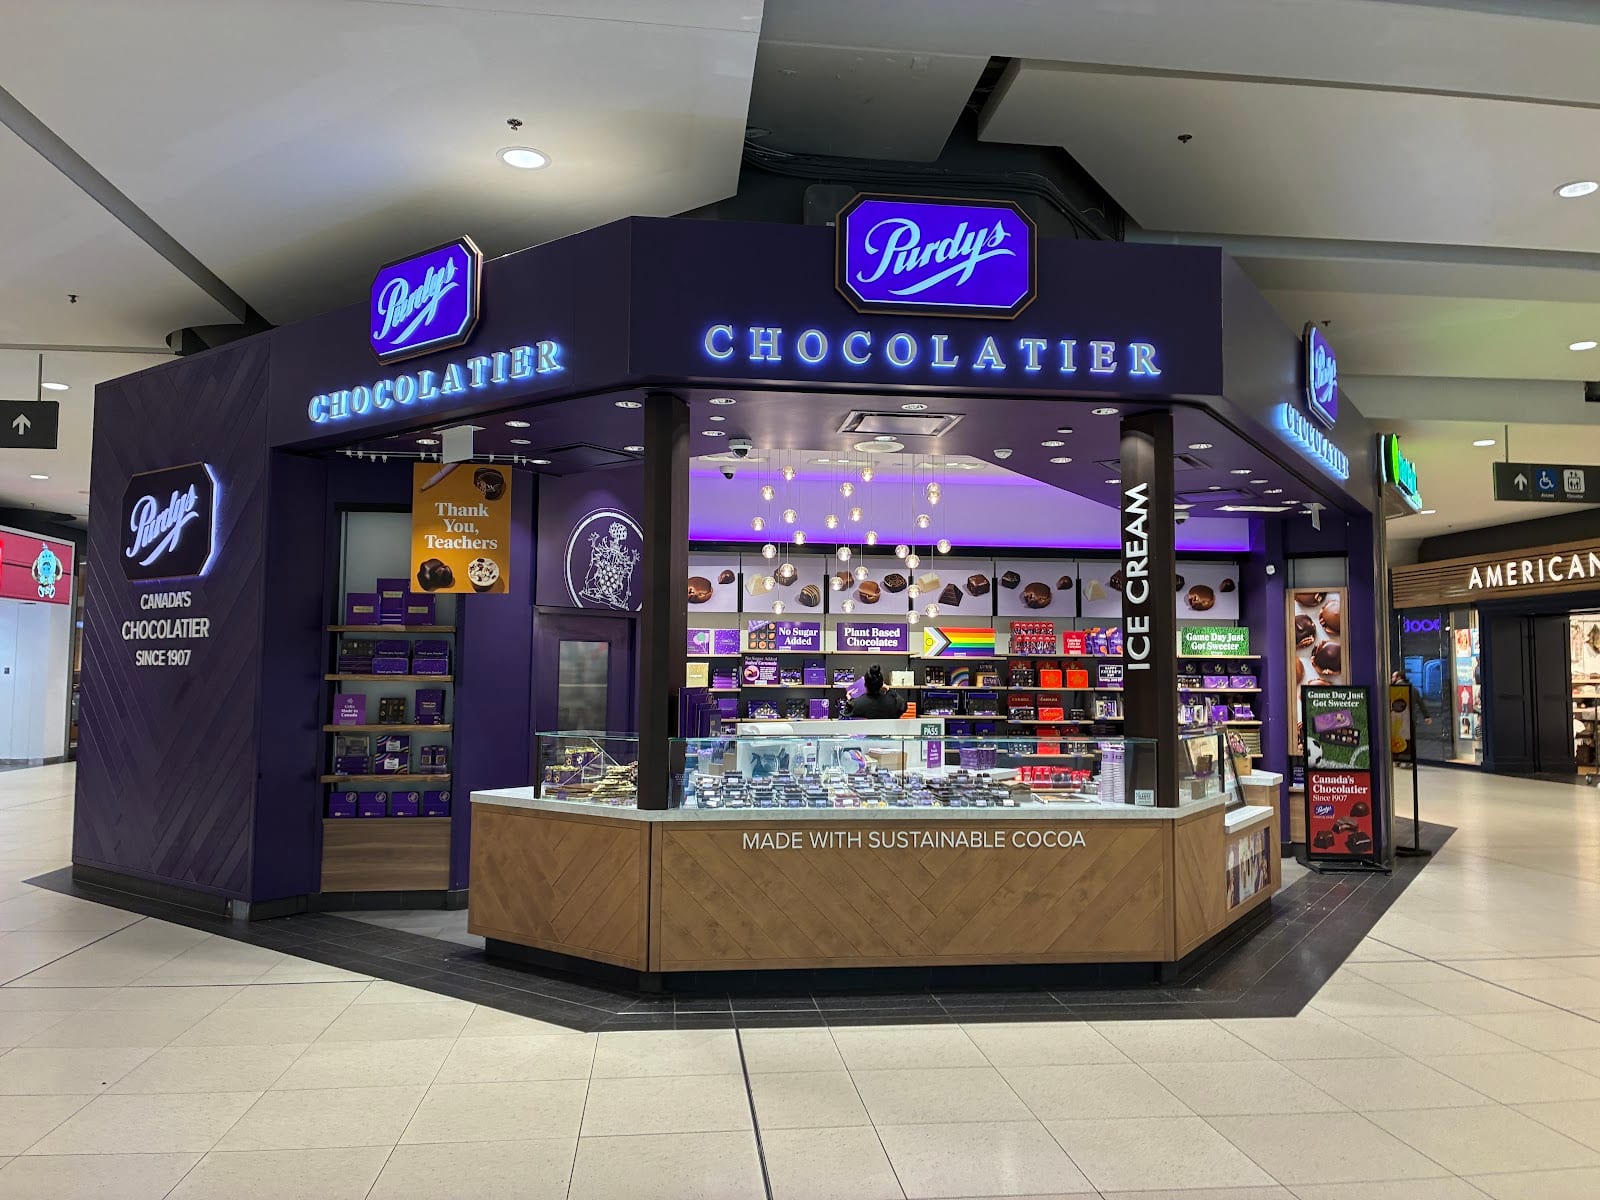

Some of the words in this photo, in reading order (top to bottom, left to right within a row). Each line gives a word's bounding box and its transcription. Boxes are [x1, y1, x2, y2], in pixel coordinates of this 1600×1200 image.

[856, 217, 1016, 296] Purdys
[373, 257, 460, 344] Purdys
[704, 324, 1162, 376] CHOCOLATIER
[308, 340, 562, 423] CHOCOLATIER
[435, 502, 489, 517] Thank
[126, 483, 199, 566] Purdys
[443, 518, 479, 535] You,
[424, 535, 498, 550] Teachers
[1124, 482, 1150, 604] CREAM
[1468, 551, 1600, 590] AMERICAN
[140, 591, 192, 610] CANADA'S
[121, 617, 210, 640] CHOCOLATIER
[779, 627, 793, 636] No
[794, 627, 818, 638] Sugar
[844, 627, 871, 637] Plant
[872, 627, 901, 638] Based
[784, 636, 812, 646] Added
[846, 637, 898, 647] Chocolates
[1127, 615, 1151, 670] ICE
[1187, 633, 1209, 641] Game
[1211, 633, 1227, 642] Day
[1227, 633, 1244, 642] Just
[1191, 642, 1206, 650] Got
[1207, 642, 1239, 651] Sweeter
[135, 649, 166, 666] SINCE
[166, 649, 192, 666] 1907
[1333, 692, 1347, 701] Day
[1347, 692, 1364, 700] Just
[923, 727, 938, 735] PASS
[1312, 775, 1354, 785] Canada's
[1312, 784, 1368, 794] Chocolatier
[743, 832, 803, 850] MADE
[809, 831, 862, 849] WITH
[868, 831, 1005, 849] SUSTAINABLE
[1011, 830, 1086, 848] COCOA
